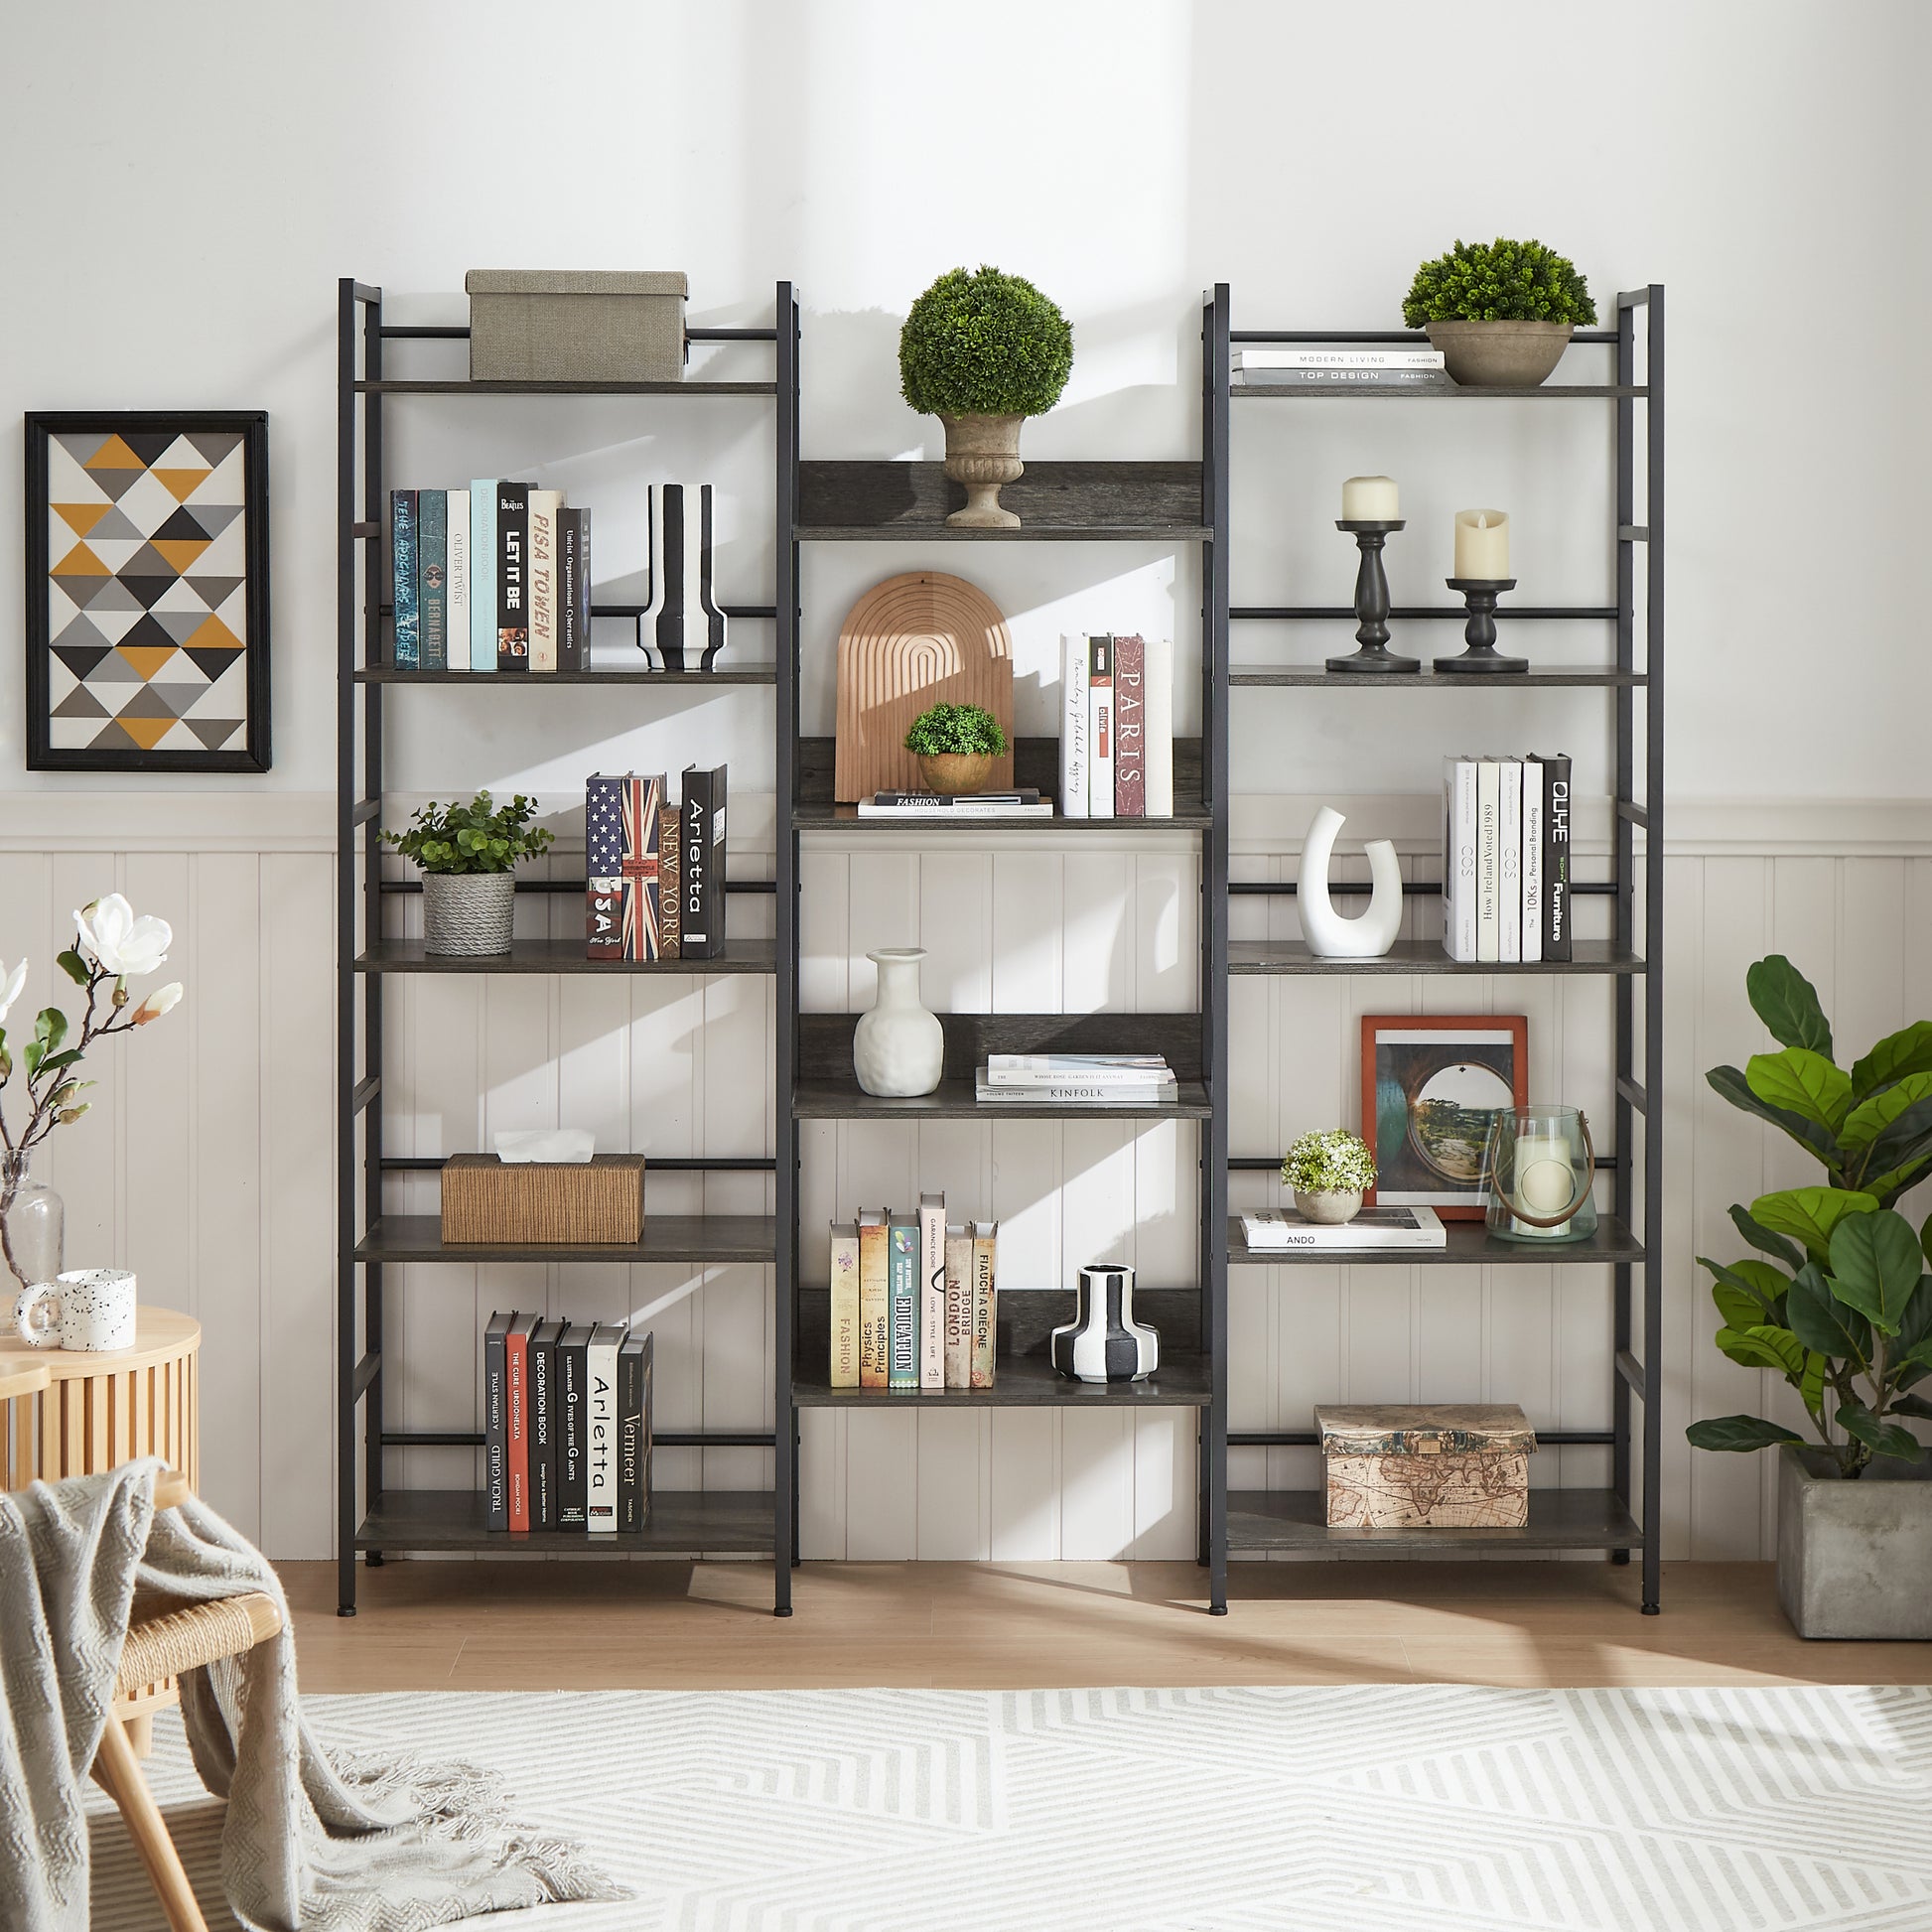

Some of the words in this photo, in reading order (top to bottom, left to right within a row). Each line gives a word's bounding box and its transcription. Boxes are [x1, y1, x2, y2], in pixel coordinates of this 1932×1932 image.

[480, 487, 489, 551] DECORATION
[533, 512, 550, 561] PISA
[454, 533, 463, 573] OLIVER
[480, 553, 489, 581] BOOK
[506, 531, 520, 563] LET
[454, 574, 464, 607] TWIST
[506, 567, 520, 583] IT
[565, 557, 574, 607] Organizational
[506, 587, 520, 610] BE
[565, 610, 574, 649] Cybernetics
[1099, 708, 1108, 733] olivia
[1120, 671, 1141, 782] PARIS
[897, 797, 940, 806] FASHION
[1529, 807, 1539, 843] Branding
[663, 823, 678, 875] NEW
[689, 798, 704, 913] Arletta
[1460, 844, 1473, 878] COS
[1504, 847, 1517, 879] COS
[1529, 844, 1538, 877] Personal
[595, 879, 612, 933] USA
[663, 886, 678, 948] YORK
[1483, 897, 1493, 920] How
[1527, 885, 1538, 911] 10Ks
[1552, 883, 1564, 941] Furniture
[1050, 1088, 1104, 1098] KINFOLK
[948, 1280, 961, 1347] LONDON
[961, 1290, 971, 1336] BRIDGE
[840, 1318, 851, 1374] FASHION
[862, 1321, 873, 1368] Physics
[875, 1315, 886, 1374] Principles
[896, 1296, 913, 1372] EDUCATION
[536, 1351, 546, 1415] DECORATION
[537, 1416, 547, 1446] BOOK
[593, 1376, 611, 1488] Arletta
[623, 1413, 641, 1486] Vermeer
[491, 1445, 501, 1477] GUILD
[491, 1477, 501, 1513] TRICIA
